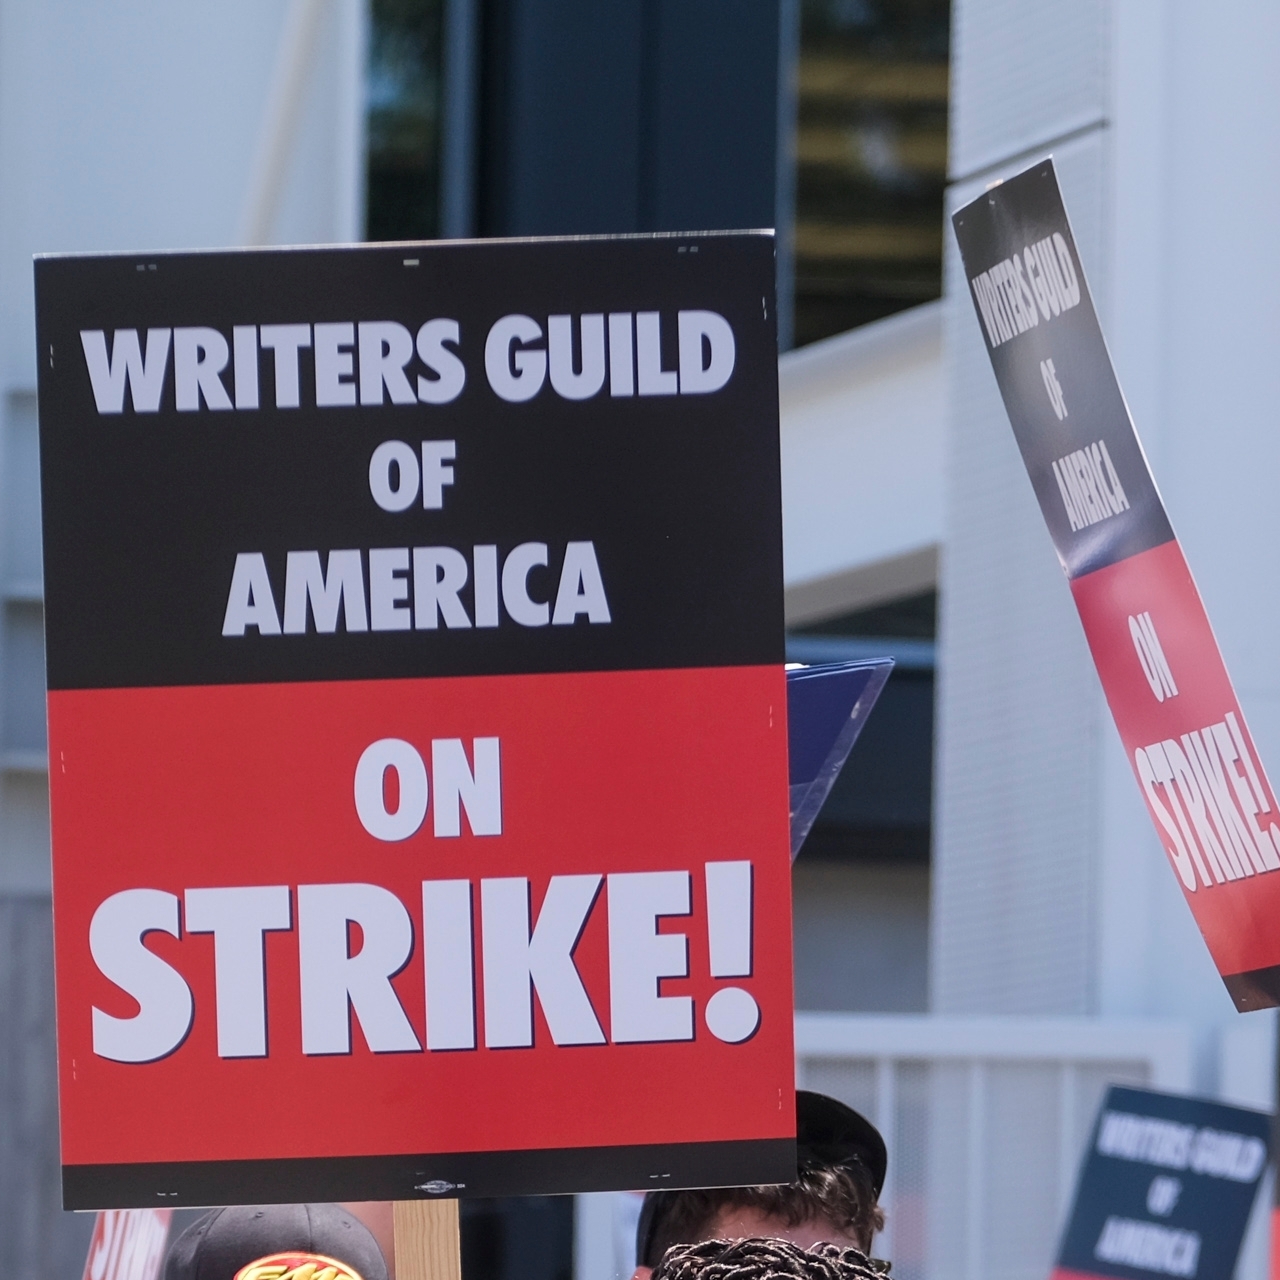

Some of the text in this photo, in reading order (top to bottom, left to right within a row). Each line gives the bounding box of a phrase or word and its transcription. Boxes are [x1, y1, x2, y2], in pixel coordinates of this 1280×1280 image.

[971, 231, 1081, 349] WRITERS GUILD
[80, 310, 736, 414] WRITERS GUILD
[1040, 357, 1064, 421] OF
[368, 439, 456, 513] OF
[1052, 439, 1131, 532] AMERICA
[221, 540, 612, 637] AMERICA
[1128, 610, 1179, 703] ON
[353, 736, 502, 842] ON
[88, 859, 763, 1064] STRIKE!
